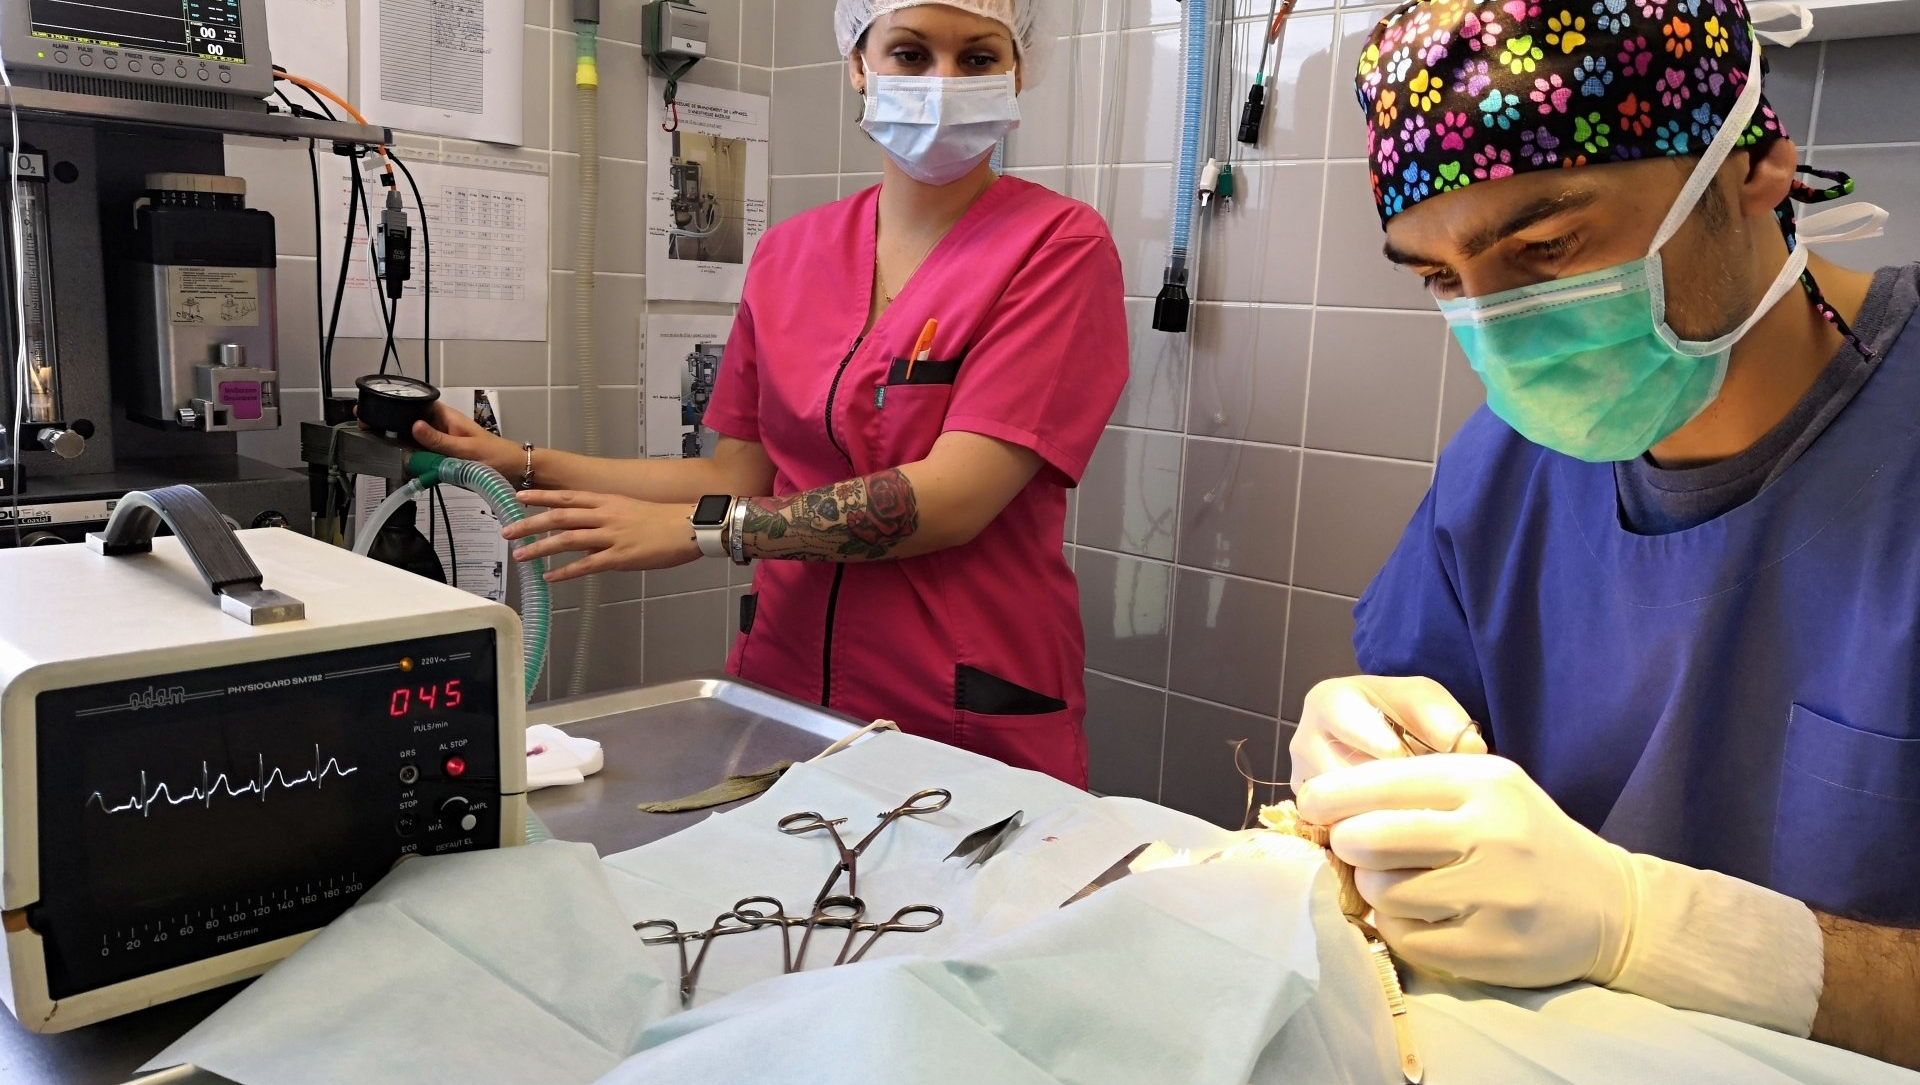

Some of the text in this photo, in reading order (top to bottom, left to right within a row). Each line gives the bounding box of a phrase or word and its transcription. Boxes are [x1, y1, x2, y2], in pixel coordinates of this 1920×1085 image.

[200, 27, 216, 39] 00
[207, 43, 224, 56] 00
[227, 678, 291, 694] PHYSIOGARD
[292, 674, 323, 685] SM782
[390, 680, 461, 716] 045
[413, 721, 449, 733] PULS/min
[439, 738, 468, 751] AL STOP
[399, 748, 417, 758] QRS
[399, 799, 418, 810] STOP
[469, 802, 488, 812] AMPL
[101, 882, 363, 957] 0 20 40 60 80 100 120 140 160 180 200
[216, 927, 259, 943] PULS/min
